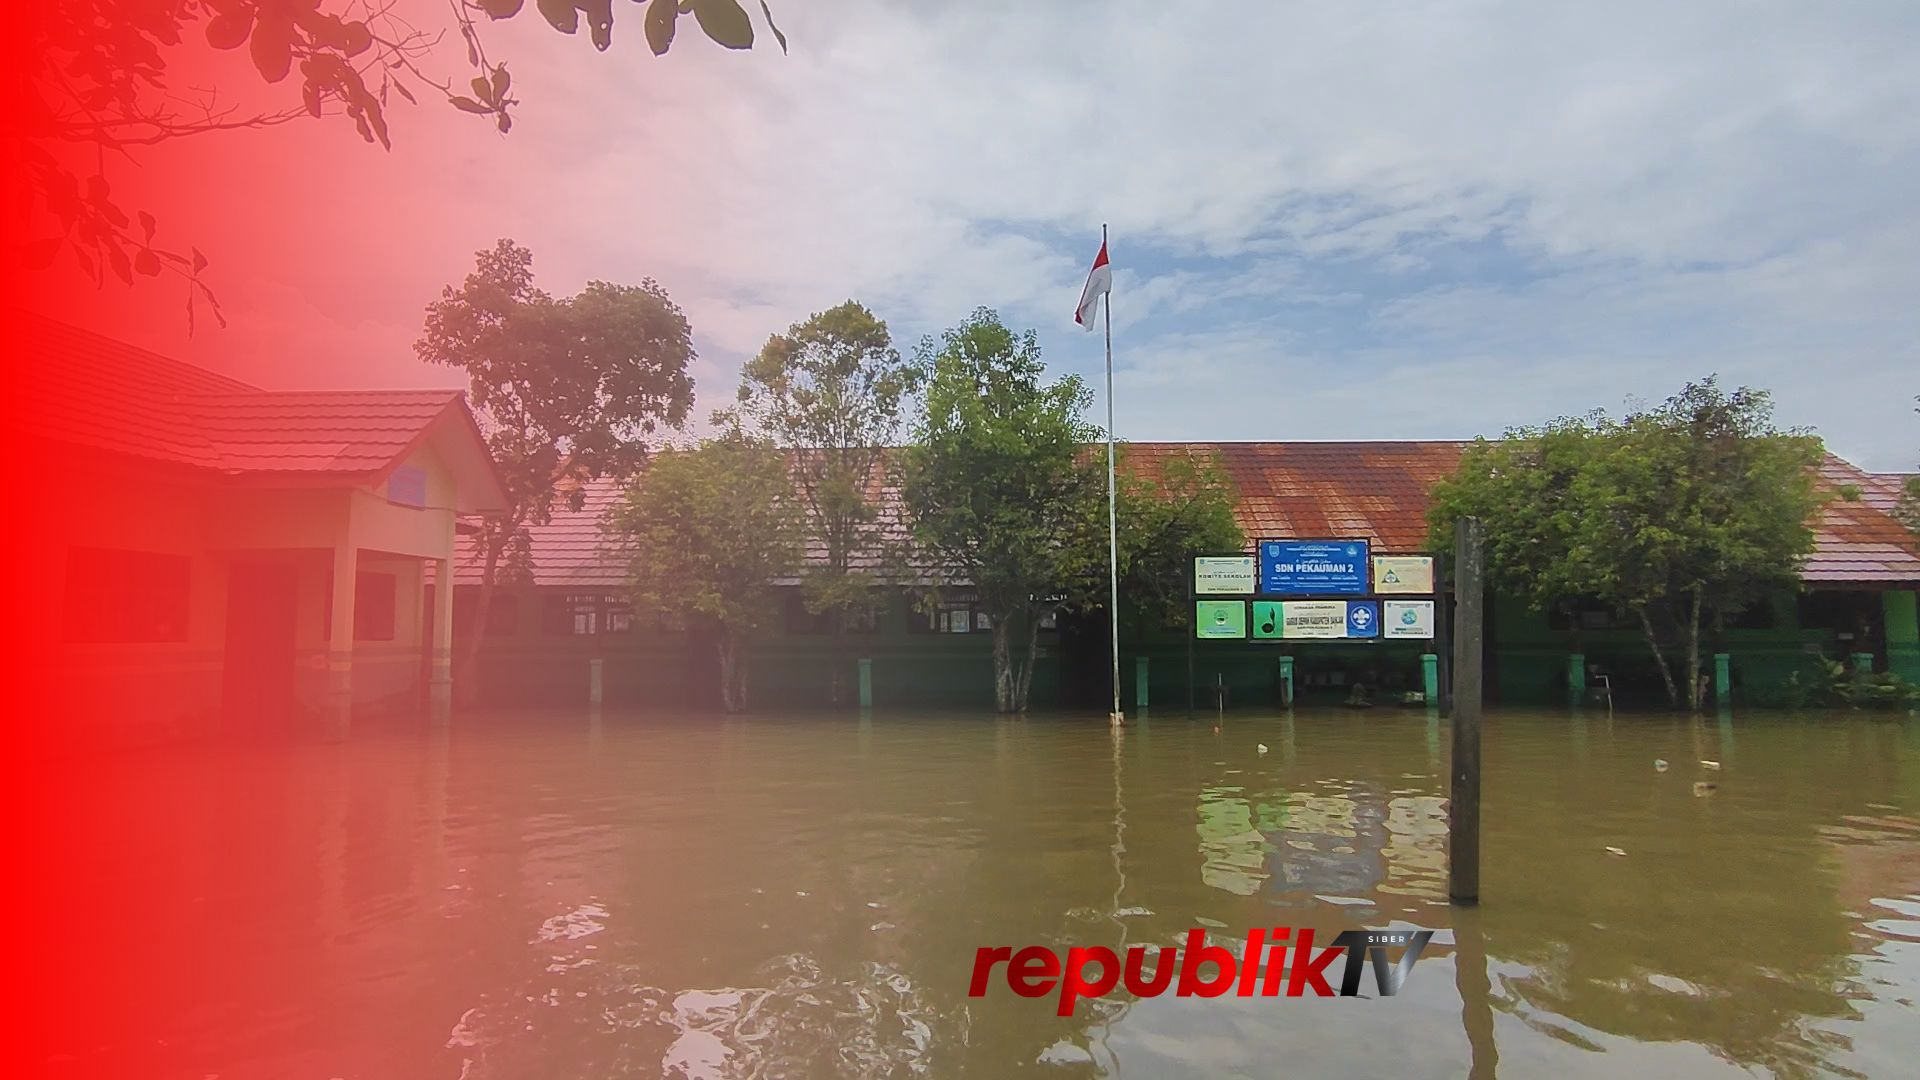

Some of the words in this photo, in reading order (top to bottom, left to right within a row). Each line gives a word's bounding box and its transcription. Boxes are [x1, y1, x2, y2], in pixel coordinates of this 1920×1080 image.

[1275, 563, 1294, 573] SDN
[1295, 563, 1346, 573] PEKAUMAN
[1347, 563, 1354, 573] 2
